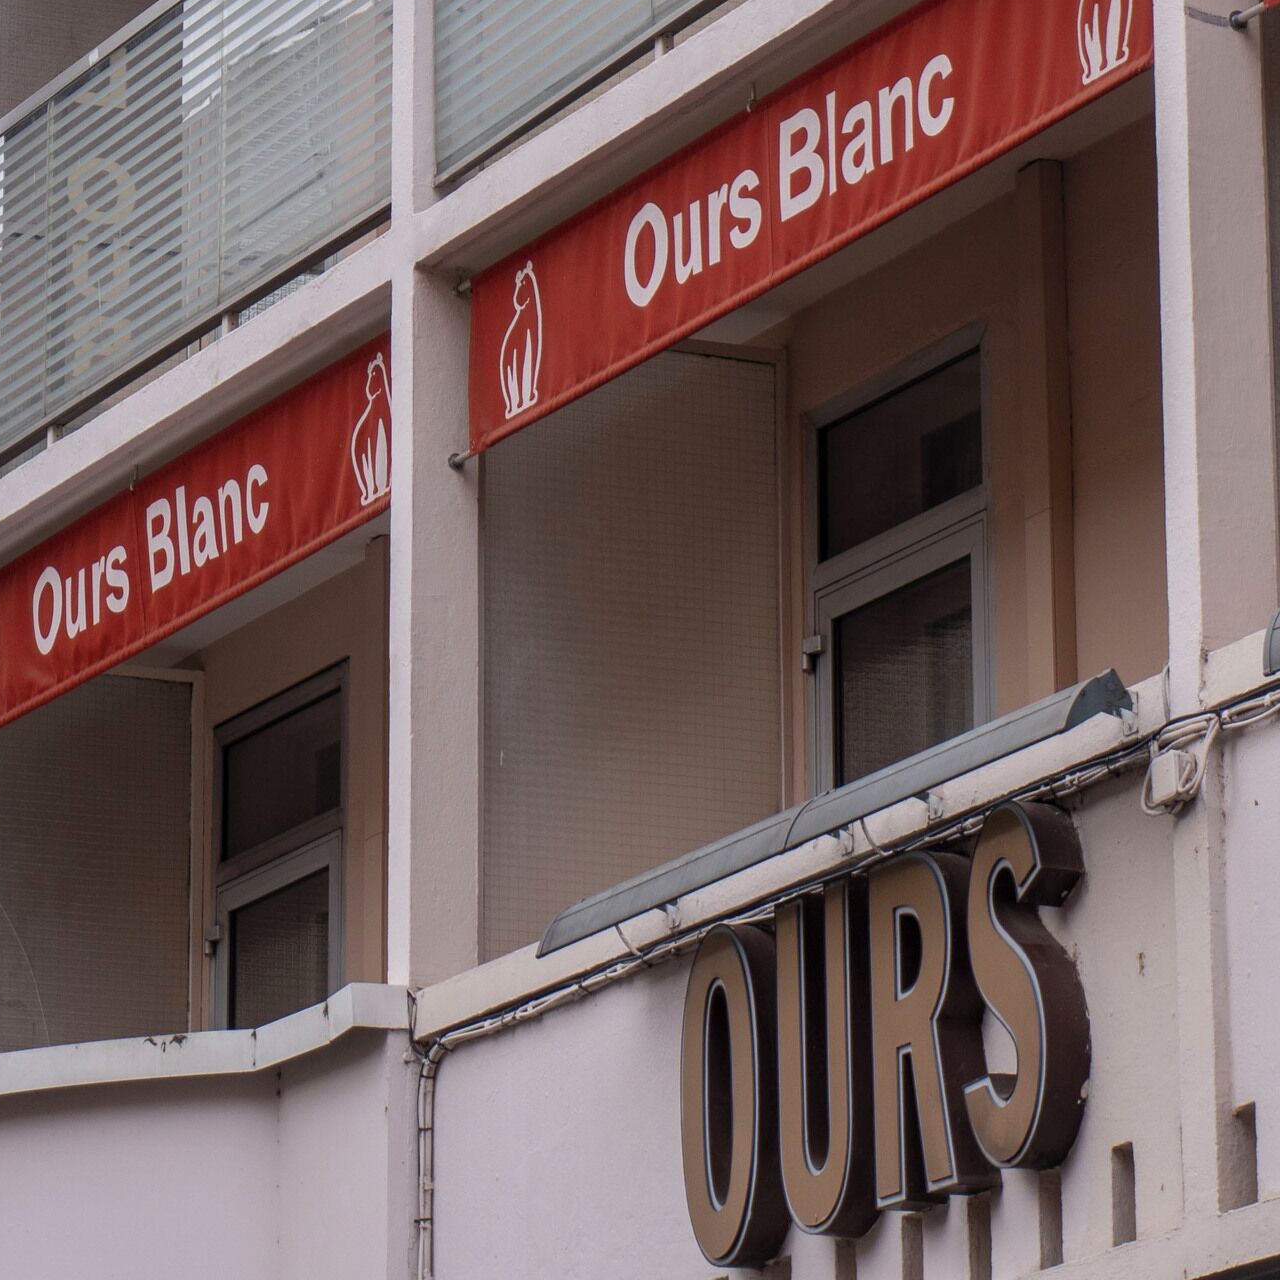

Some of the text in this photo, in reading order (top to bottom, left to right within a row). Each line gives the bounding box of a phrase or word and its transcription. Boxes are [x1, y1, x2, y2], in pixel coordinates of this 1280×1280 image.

[624, 54, 954, 307] Ours Blanc
[32, 464, 269, 655] Ours Blanc
[680, 799, 1048, 1268] OURS
